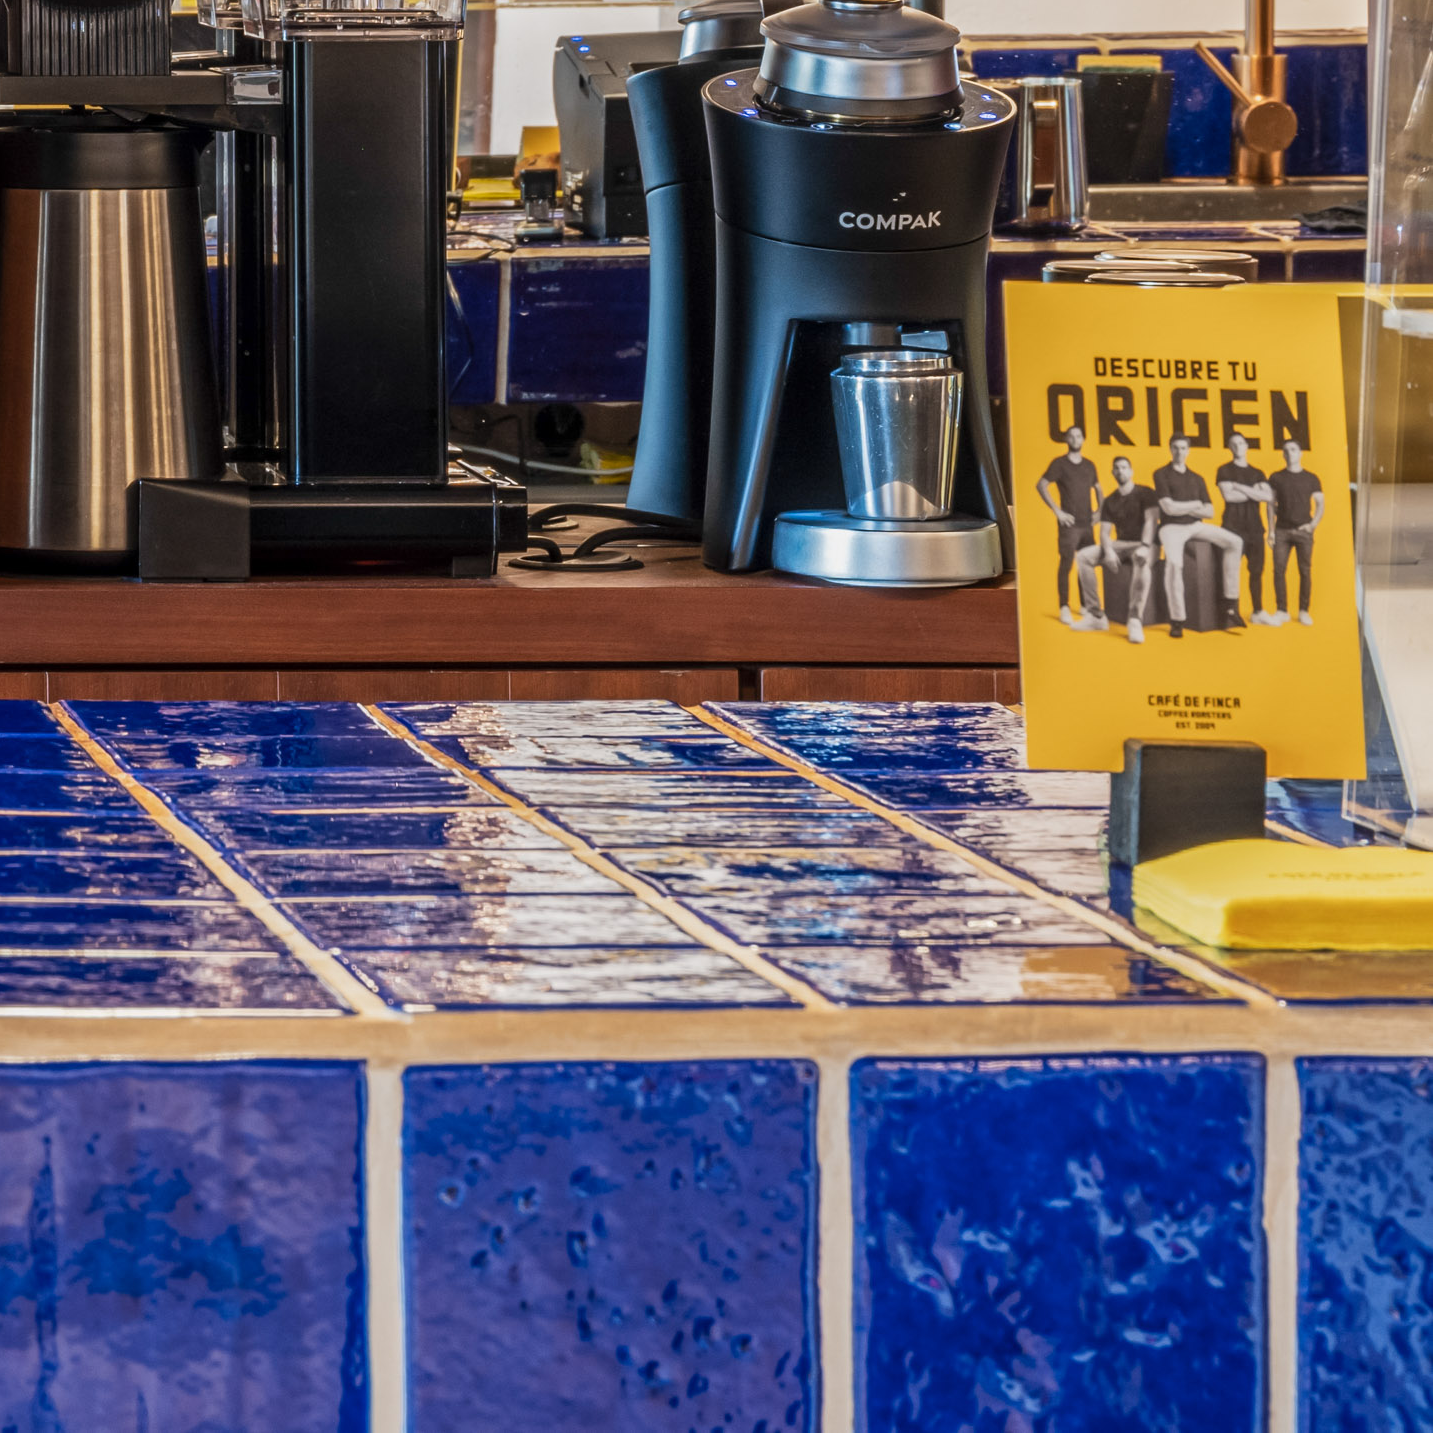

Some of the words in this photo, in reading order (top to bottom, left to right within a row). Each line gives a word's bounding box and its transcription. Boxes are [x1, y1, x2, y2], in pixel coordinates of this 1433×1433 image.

[839, 209, 942, 231] COMPAK
[1094, 356, 1220, 381] DESCUBRE
[1228, 361, 1257, 381] TU
[1046, 383, 1311, 452] ORIGEN
[1148, 693, 1181, 708] CAFÉ
[1184, 695, 1201, 708] DE
[1203, 696, 1241, 709] FINCA
